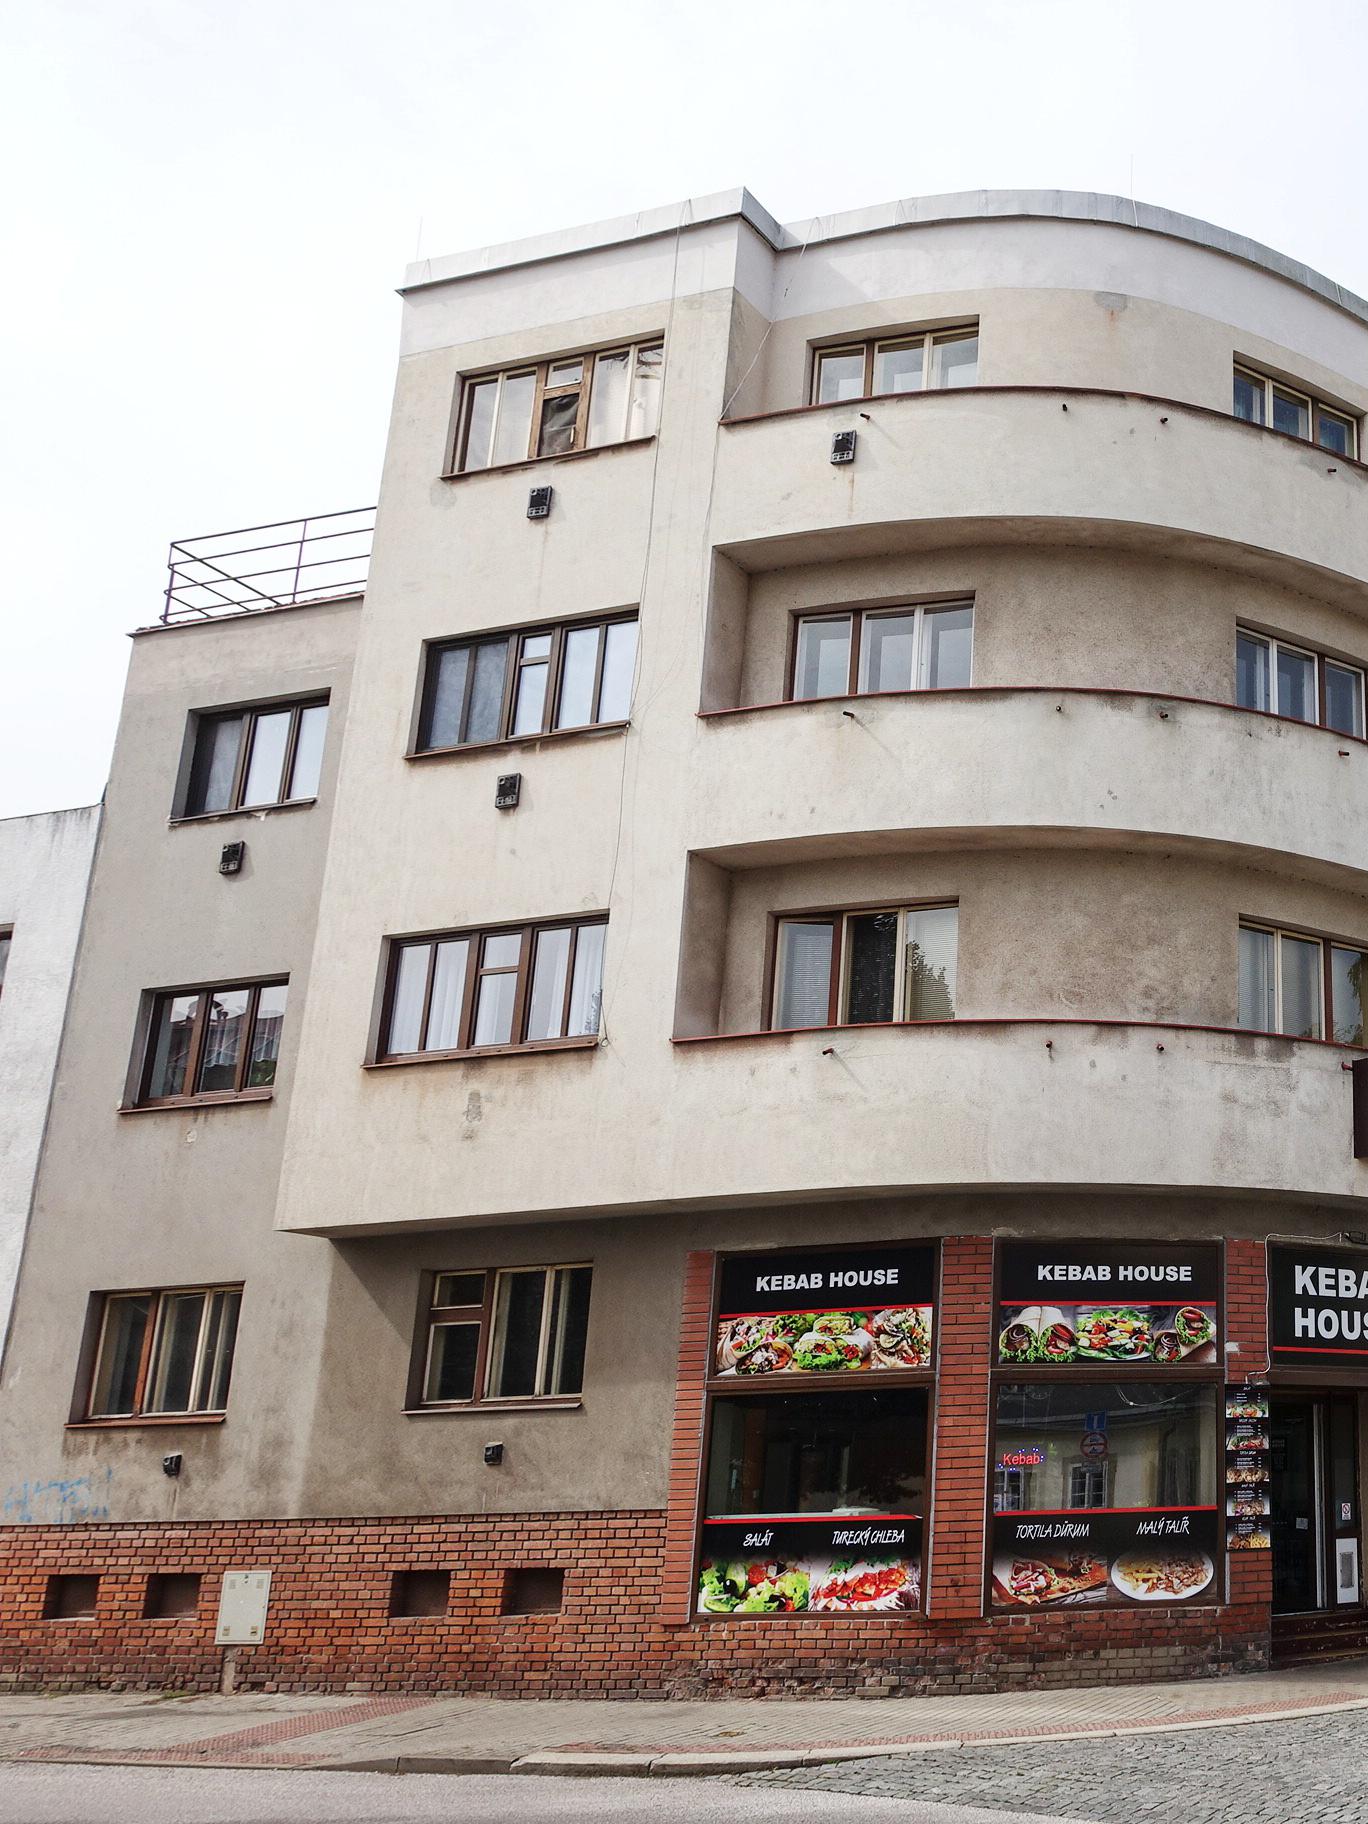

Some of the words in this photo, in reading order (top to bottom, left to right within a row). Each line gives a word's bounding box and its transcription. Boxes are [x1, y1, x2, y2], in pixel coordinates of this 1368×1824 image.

[756, 1273, 823, 1292] KEBAB
[829, 1268, 899, 1288] HOUSE
[1037, 1265, 1112, 1281] KEBAB
[1118, 1265, 1193, 1282] HOUSE
[1003, 1452, 1041, 1466] Kebab
[1015, 1524, 1052, 1539] TORTILA
[1136, 1516, 1165, 1536] MALÝ
[1165, 1516, 1190, 1535] TALÍŘ
[743, 1529, 774, 1547] SALÁT
[832, 1527, 872, 1546] TURECKÝ
[870, 1529, 905, 1544] CHLEBA
